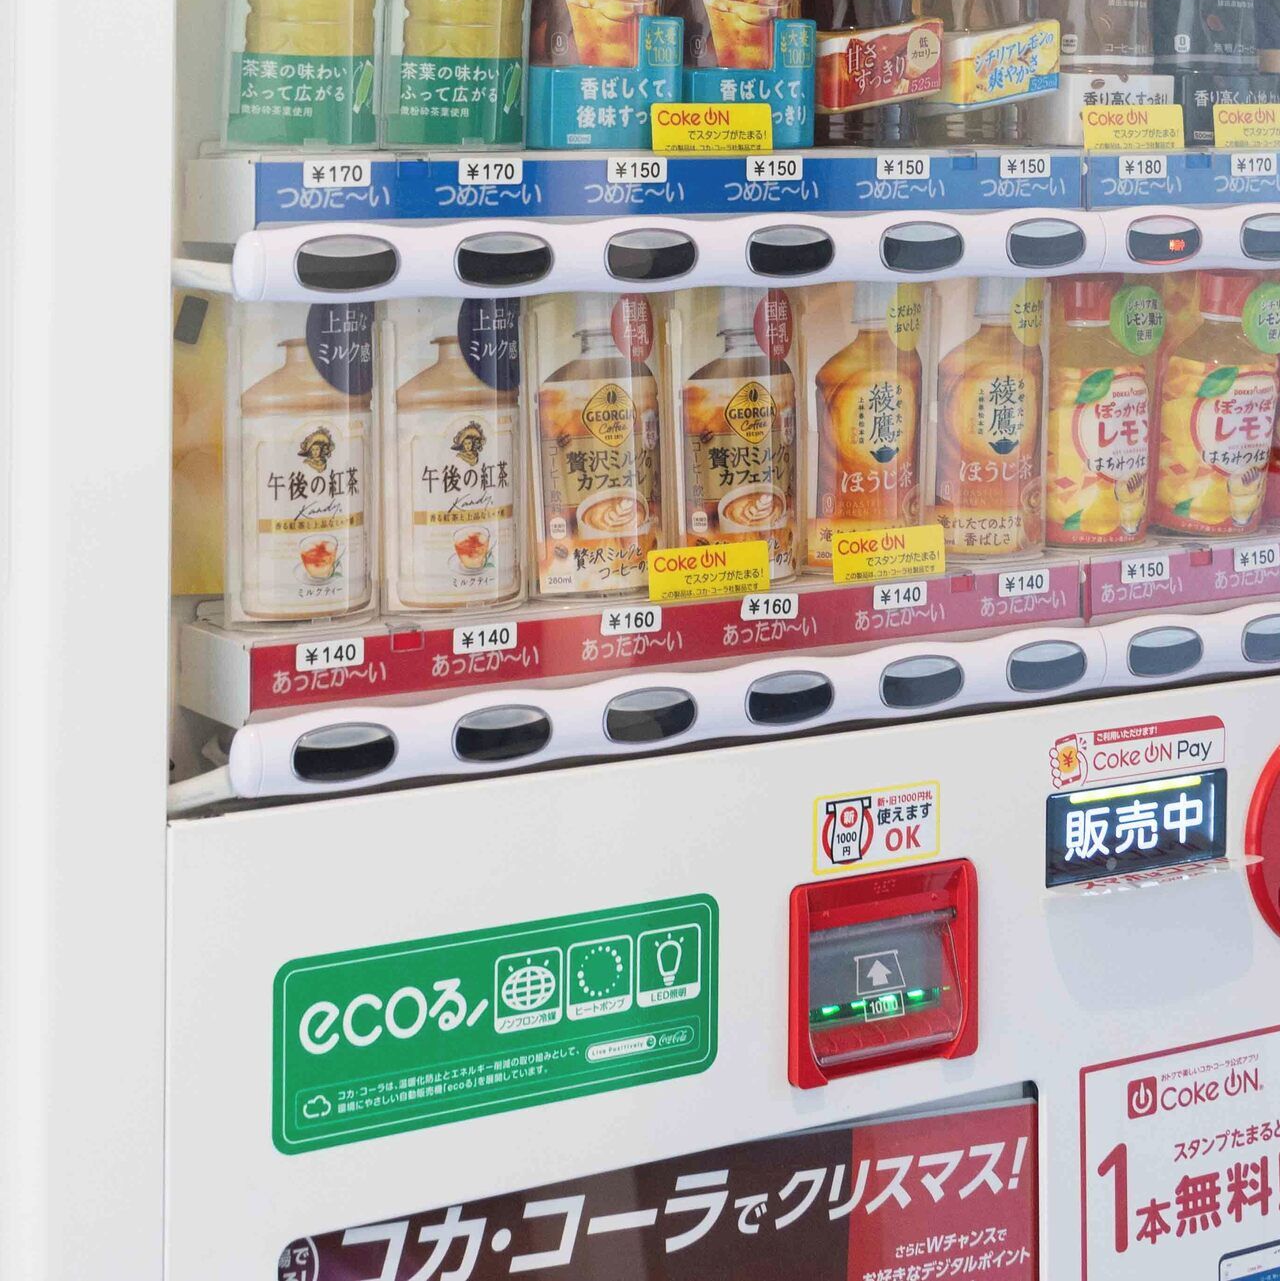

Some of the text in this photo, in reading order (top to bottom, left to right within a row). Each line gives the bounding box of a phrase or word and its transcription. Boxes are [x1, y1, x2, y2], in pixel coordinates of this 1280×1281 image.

[911, 49, 938, 59] カロリー
[974, 31, 1054, 73] シチリアレモンの
[242, 59, 347, 80] 茶葉の味わい
[400, 62, 500, 82] 茶葉の味わい
[580, 78, 674, 101] 香ばしくて、
[719, 79, 805, 101] 香ばしくて、
[910, 76, 940, 93] 525ml
[1031, 77, 1058, 91] 525ml
[312, 165, 363, 184] ¥170
[466, 163, 515, 180] ¥170
[616, 161, 661, 178] ¥150
[753, 159, 796, 176] ¥150
[1125, 160, 1162, 175] ¥180
[1236, 158, 1272, 172] ¥170
[622, 299, 648, 322] 国産
[764, 301, 788, 322] 国産
[1127, 298, 1158, 312] シチリア産
[321, 310, 367, 334] 上品な
[1126, 312, 1163, 327] レモン果汁
[623, 322, 649, 345] 牛乳
[766, 323, 789, 344] 牛乳
[1136, 329, 1154, 341] 使用
[317, 343, 371, 365] ミルク感
[469, 340, 518, 361] ミルク感
[868, 380, 895, 445] 綾鷹
[989, 374, 1018, 436] 綾鷹
[566, 449, 652, 474] 贅沢ミルクの
[959, 456, 1033, 482] ほうじ茶
[267, 466, 360, 501] 午後の紅茶
[577, 469, 648, 491] カフェオレ
[719, 468, 785, 487] カフェオレ
[841, 462, 914, 494] ほうじ茶
[963, 534, 1011, 547] 香ばしさ
[548, 575, 572, 586] 280ml
[1005, 575, 1044, 592] ¥140
[298, 586, 343, 599] ミルクティー
[880, 586, 921, 605] ¥140
[748, 598, 792, 615] ¥160
[609, 610, 655, 629] ¥160
[461, 627, 510, 649] ¥140
[305, 643, 356, 665] ¥140
[1096, 726, 1158, 743] ご利用いただけます!
[877, 790, 933, 807] 新・旧1000円札
[877, 802, 932, 825] 使えます
[1064, 792, 1203, 861] 販売中
[836, 831, 857, 844] 1000
[885, 824, 921, 852] OK
[842, 845, 851, 857] 円
[649, 986, 688, 1003] LED照明
[573, 997, 625, 1018] ヒートポンプ
[868, 997, 898, 1014] 1000
[497, 1011, 558, 1032] ノンフロン冷媒
[340, 1136, 1029, 1281] コカ・コーラでクリスマス!
[895, 1227, 1007, 1259] さらにWチャンスで
